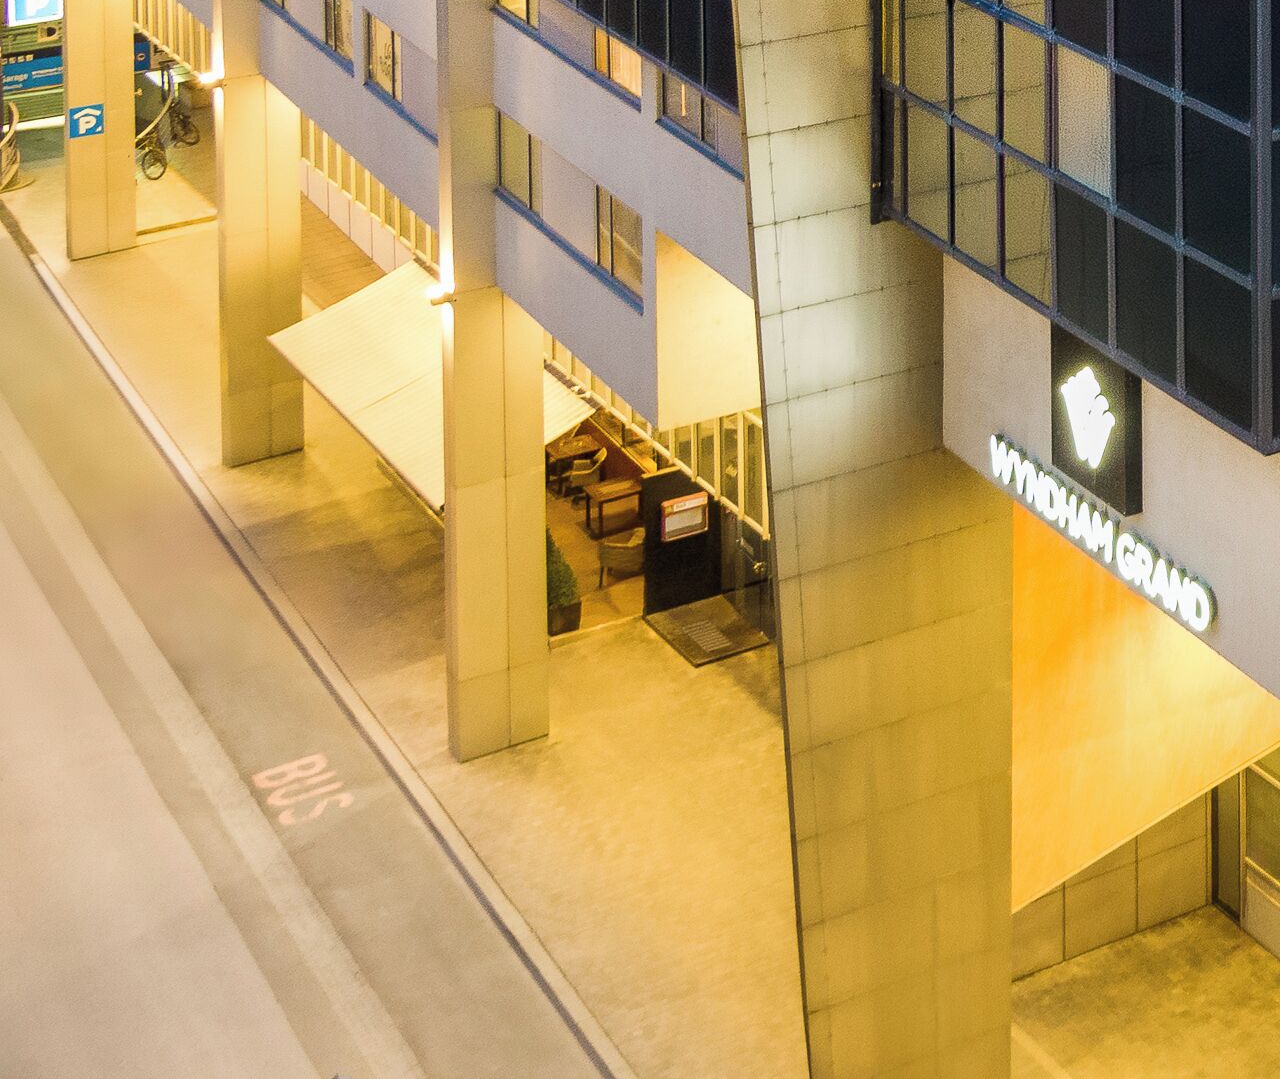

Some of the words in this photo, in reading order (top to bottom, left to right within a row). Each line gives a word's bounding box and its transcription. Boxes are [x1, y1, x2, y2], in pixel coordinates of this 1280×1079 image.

[79, 115, 97, 134] P
[990, 434, 1114, 563] WYNDHAM
[1116, 532, 1211, 631] GRAND
[252, 754, 354, 825] BUS
